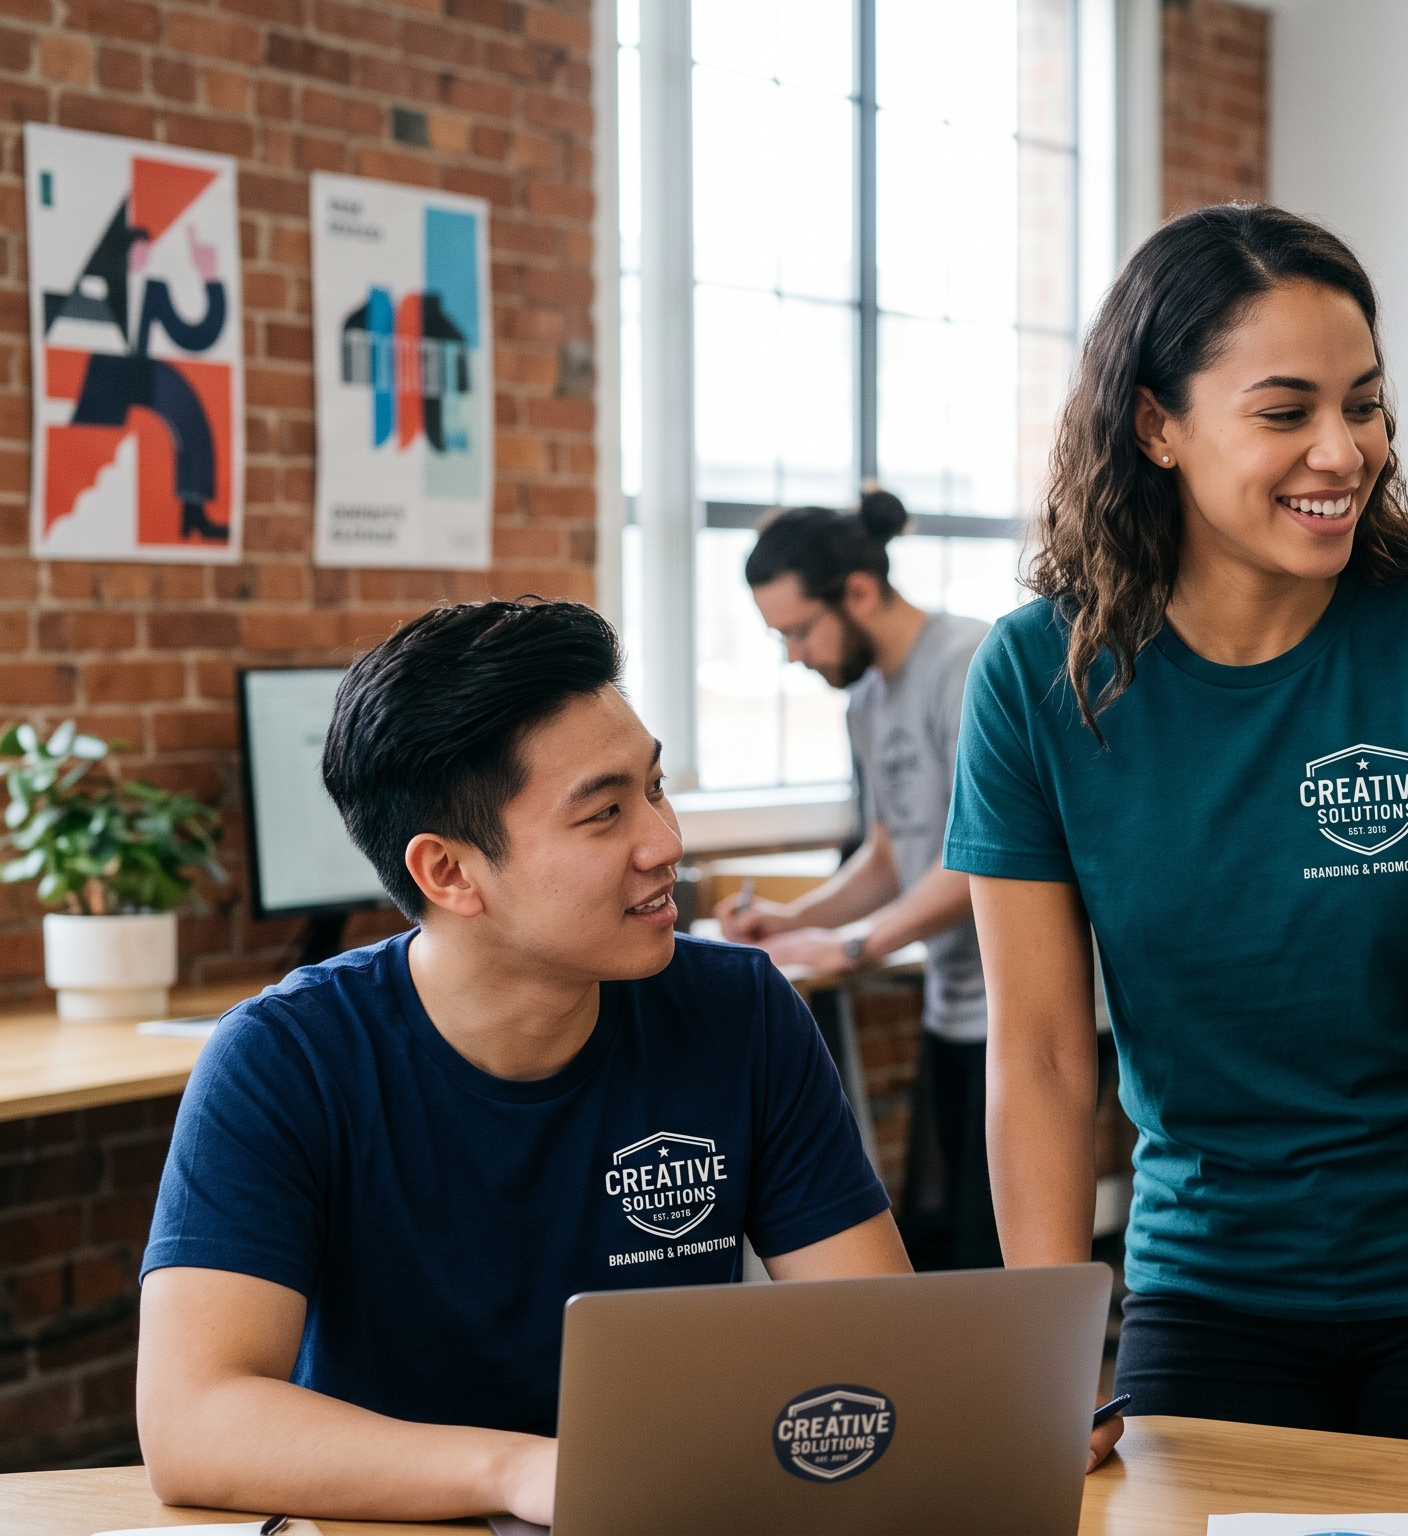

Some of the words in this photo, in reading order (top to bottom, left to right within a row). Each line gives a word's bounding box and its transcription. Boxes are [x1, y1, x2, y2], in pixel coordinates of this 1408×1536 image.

[1303, 864, 1359, 880] BRANDING
[1361, 862, 1370, 875] &
[605, 1154, 728, 1196] CREATIVE
[622, 1185, 716, 1213] SOLUTIONS
[652, 1212, 670, 1222] EST.
[608, 1248, 664, 1267] BRANDING
[666, 1246, 675, 1259] &
[676, 1235, 736, 1257] PROMOTION
[777, 1411, 891, 1442] CREATIVE
[790, 1435, 876, 1456] SOLUTIONS
